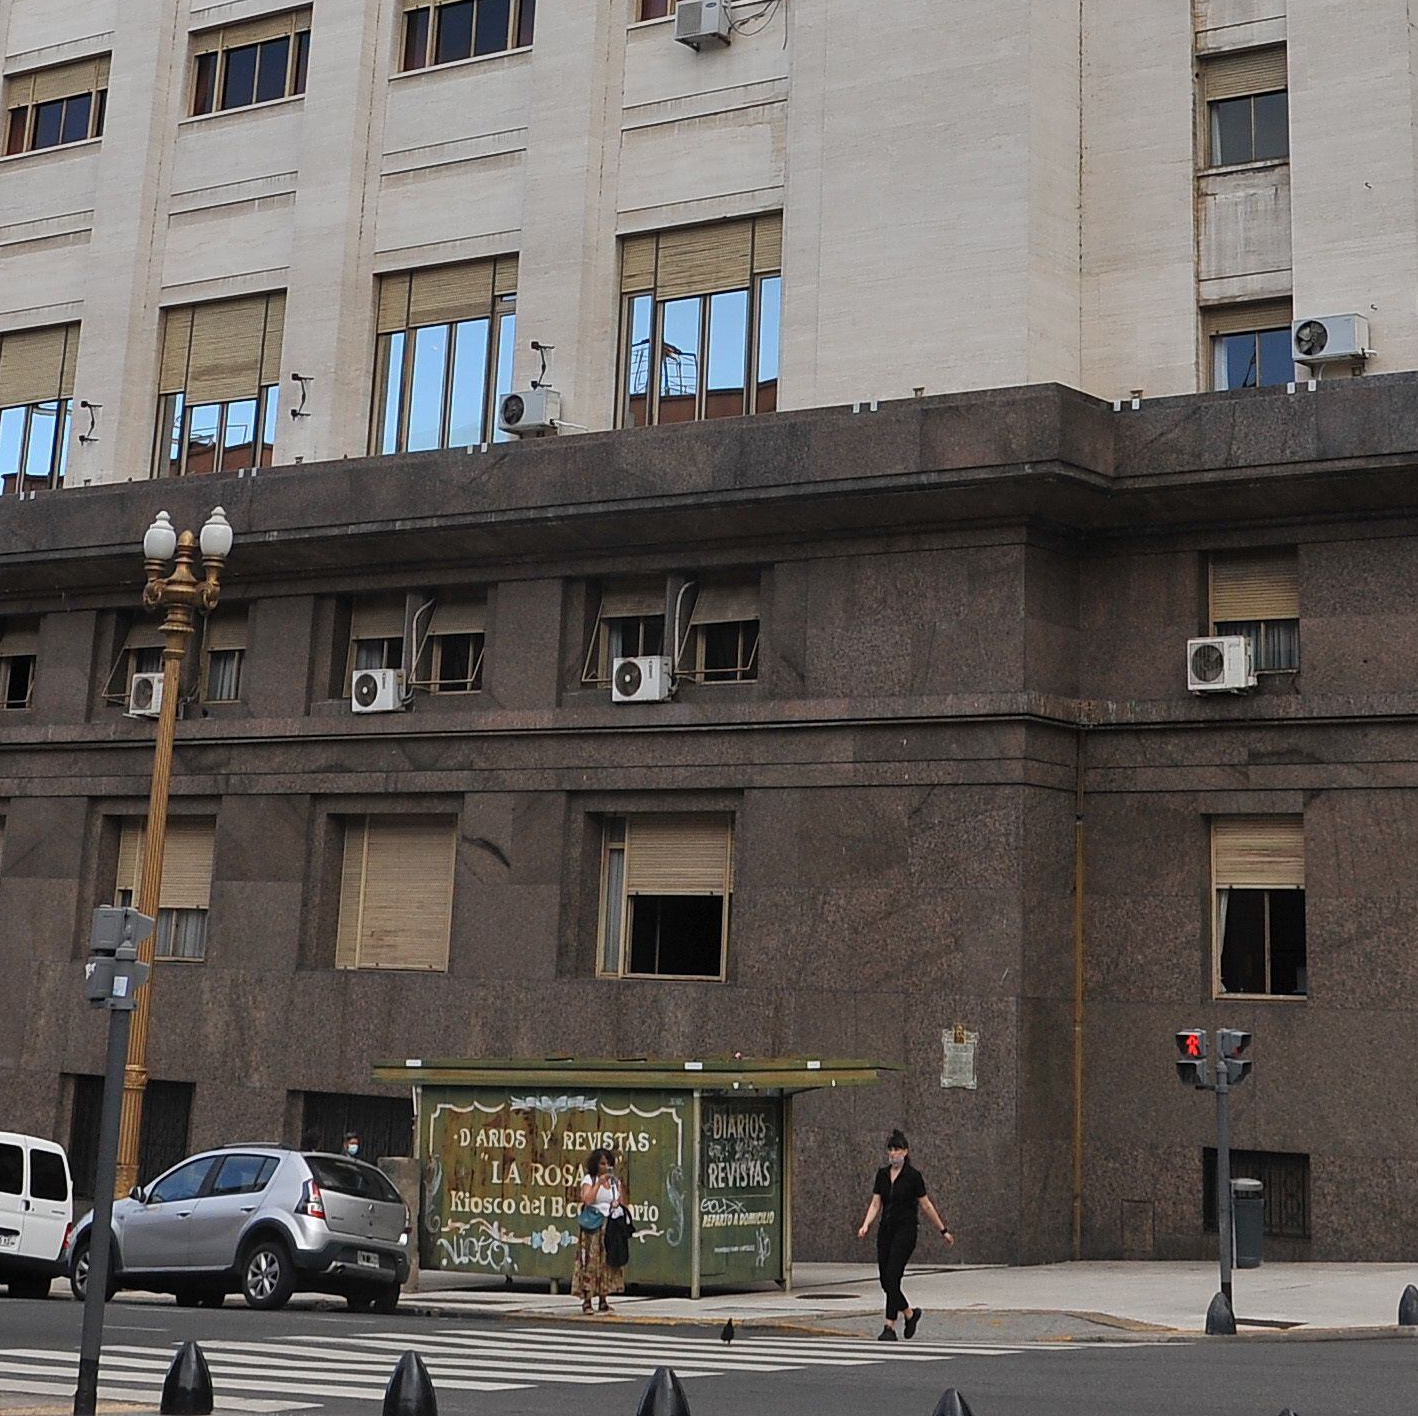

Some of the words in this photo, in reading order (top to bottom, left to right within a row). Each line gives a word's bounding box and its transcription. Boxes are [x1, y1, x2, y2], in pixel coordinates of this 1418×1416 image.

[713, 1112, 767, 1140] DIARIOS
[459, 1128, 527, 1149] DARIOS
[541, 1130, 552, 1150] Y
[562, 1130, 650, 1152] REVISTAS
[708, 1159, 771, 1189] REVISTAS
[450, 1190, 516, 1214] Kiosco
[519, 1194, 546, 1216] del
[702, 1213, 733, 1228] REPARTO
[733, 1212, 739, 1226] A
[739, 1211, 775, 1226] DOMICILIO
